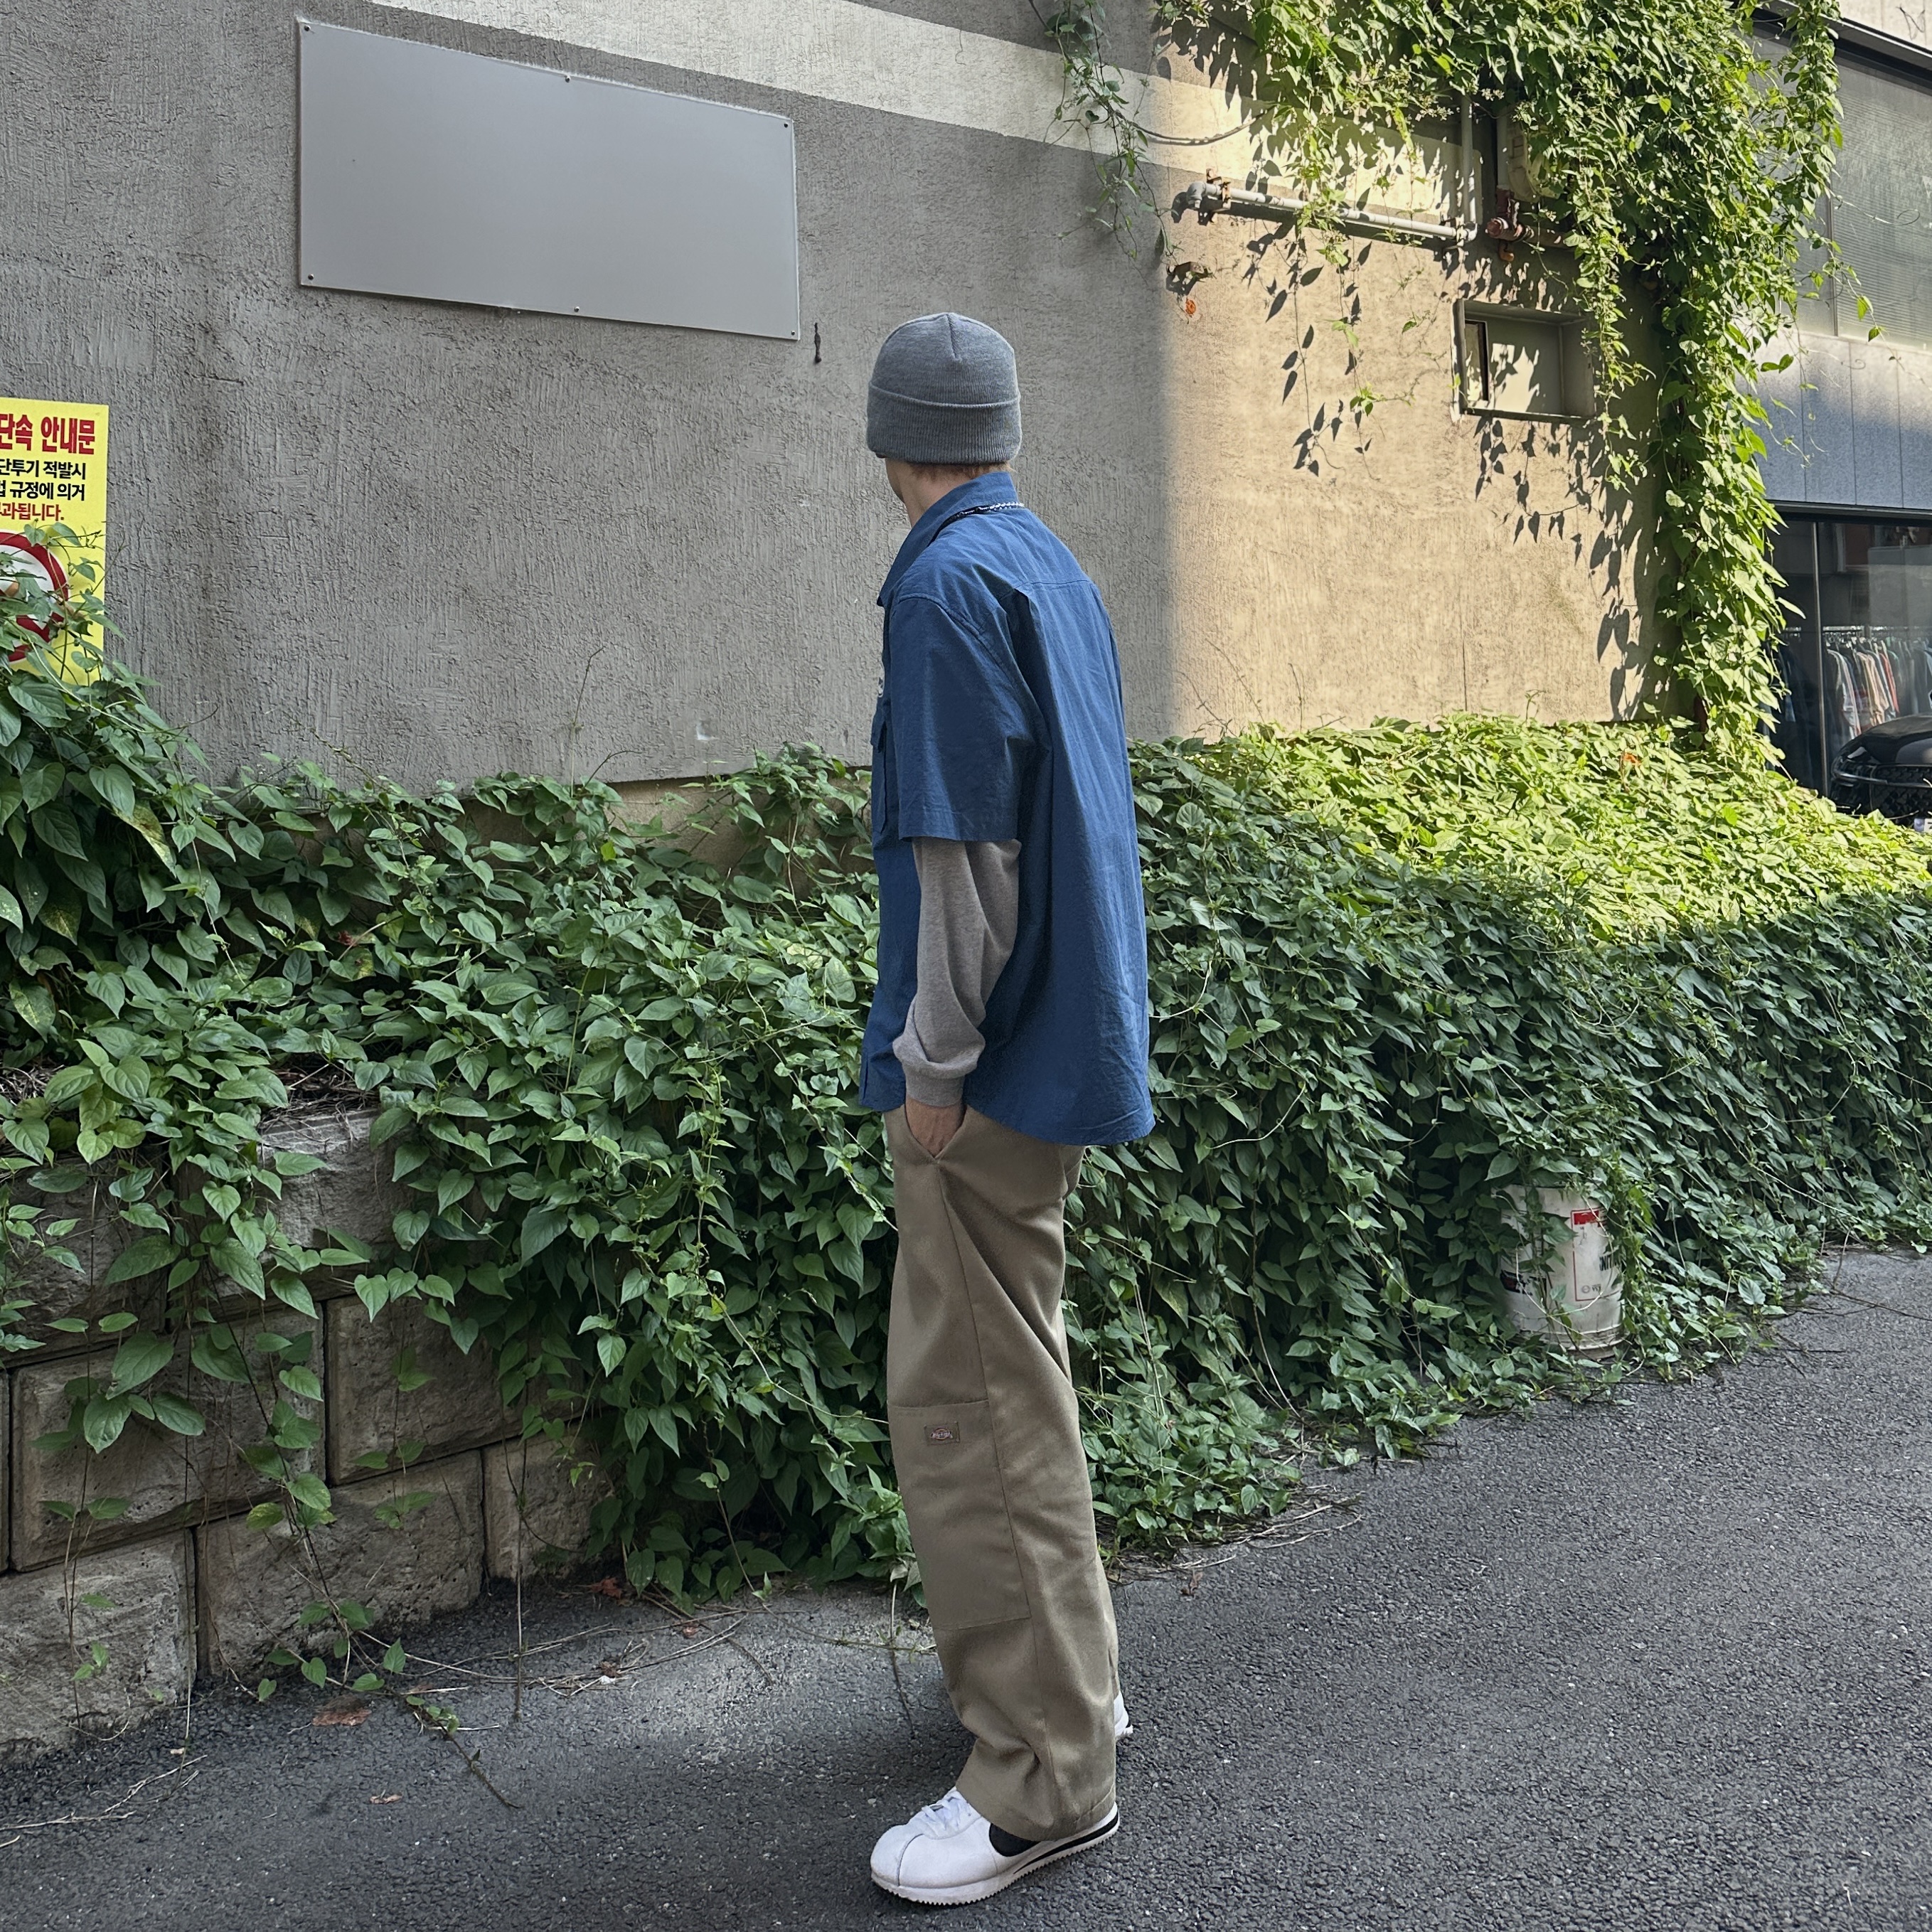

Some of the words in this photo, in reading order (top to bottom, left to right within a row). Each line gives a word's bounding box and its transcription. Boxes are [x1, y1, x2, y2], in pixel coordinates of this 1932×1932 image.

[41, 417, 95, 454] 안내문
[43, 461, 86, 480] 적발시
[10, 481, 54, 499] 규정에
[57, 484, 85, 501] 의거
[0, 502, 64, 521] 과됩니다.
